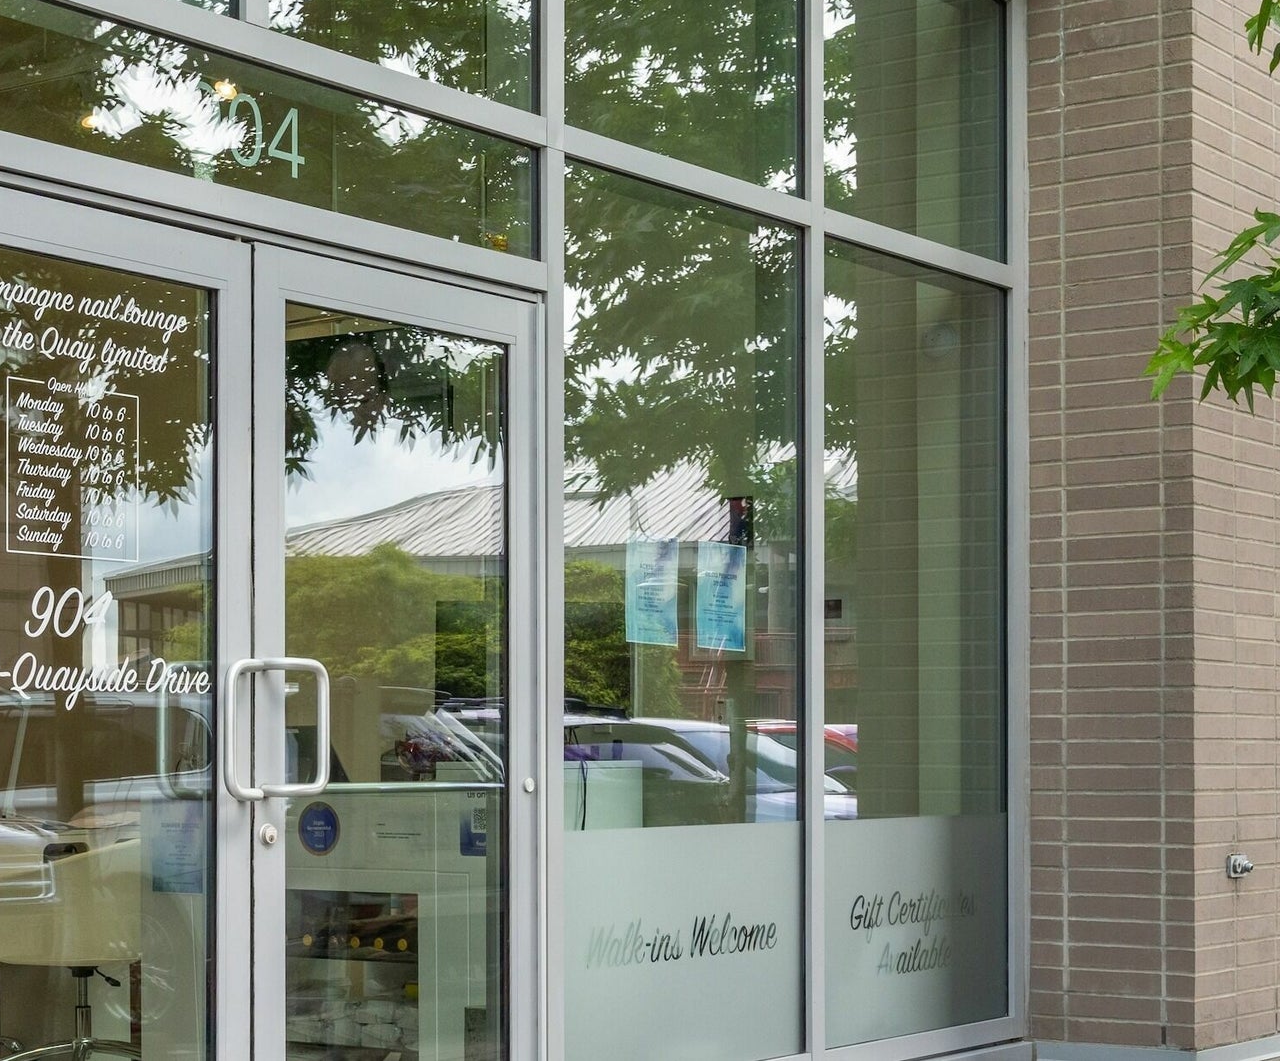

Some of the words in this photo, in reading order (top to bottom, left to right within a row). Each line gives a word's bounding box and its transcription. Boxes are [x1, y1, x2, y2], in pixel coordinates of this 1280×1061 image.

[78, 295, 121, 322] nail
[124, 297, 188, 344] lounge
[2, 320, 35, 351] the
[39, 327, 96, 373] Quay
[101, 337, 168, 373] limited
[47, 376, 73, 394] Open
[16, 392, 64, 421] Monday
[86, 403, 100, 419] 10
[102, 406, 113, 421] to
[117, 407, 126, 422] 6
[18, 414, 64, 442] Tuesday
[85, 424, 100, 439] 10
[102, 427, 113, 442] to
[115, 428, 124, 443] 6
[18, 437, 83, 466] Wednesday
[85, 445, 100, 461] 10
[102, 449, 112, 463] to
[115, 449, 125, 464] 6
[17, 458, 72, 487] Thursday
[85, 467, 100, 483] 10
[102, 470, 112, 484] to
[16, 481, 55, 507] Friday
[85, 489, 100, 504] 10
[102, 491, 112, 506] to
[16, 503, 72, 531] Saturday
[85, 510, 100, 525] 10
[102, 513, 112, 527] to
[16, 525, 63, 551] Sunday
[85, 532, 100, 547] 10
[102, 534, 111, 548] to
[24, 586, 113, 638] 904
[145, 658, 211, 695] Drive
[850, 894, 884, 944] Gift
[587, 918, 683, 970] Walk-ins
[690, 912, 778, 958] Welcome
[876, 935, 952, 975] Available
